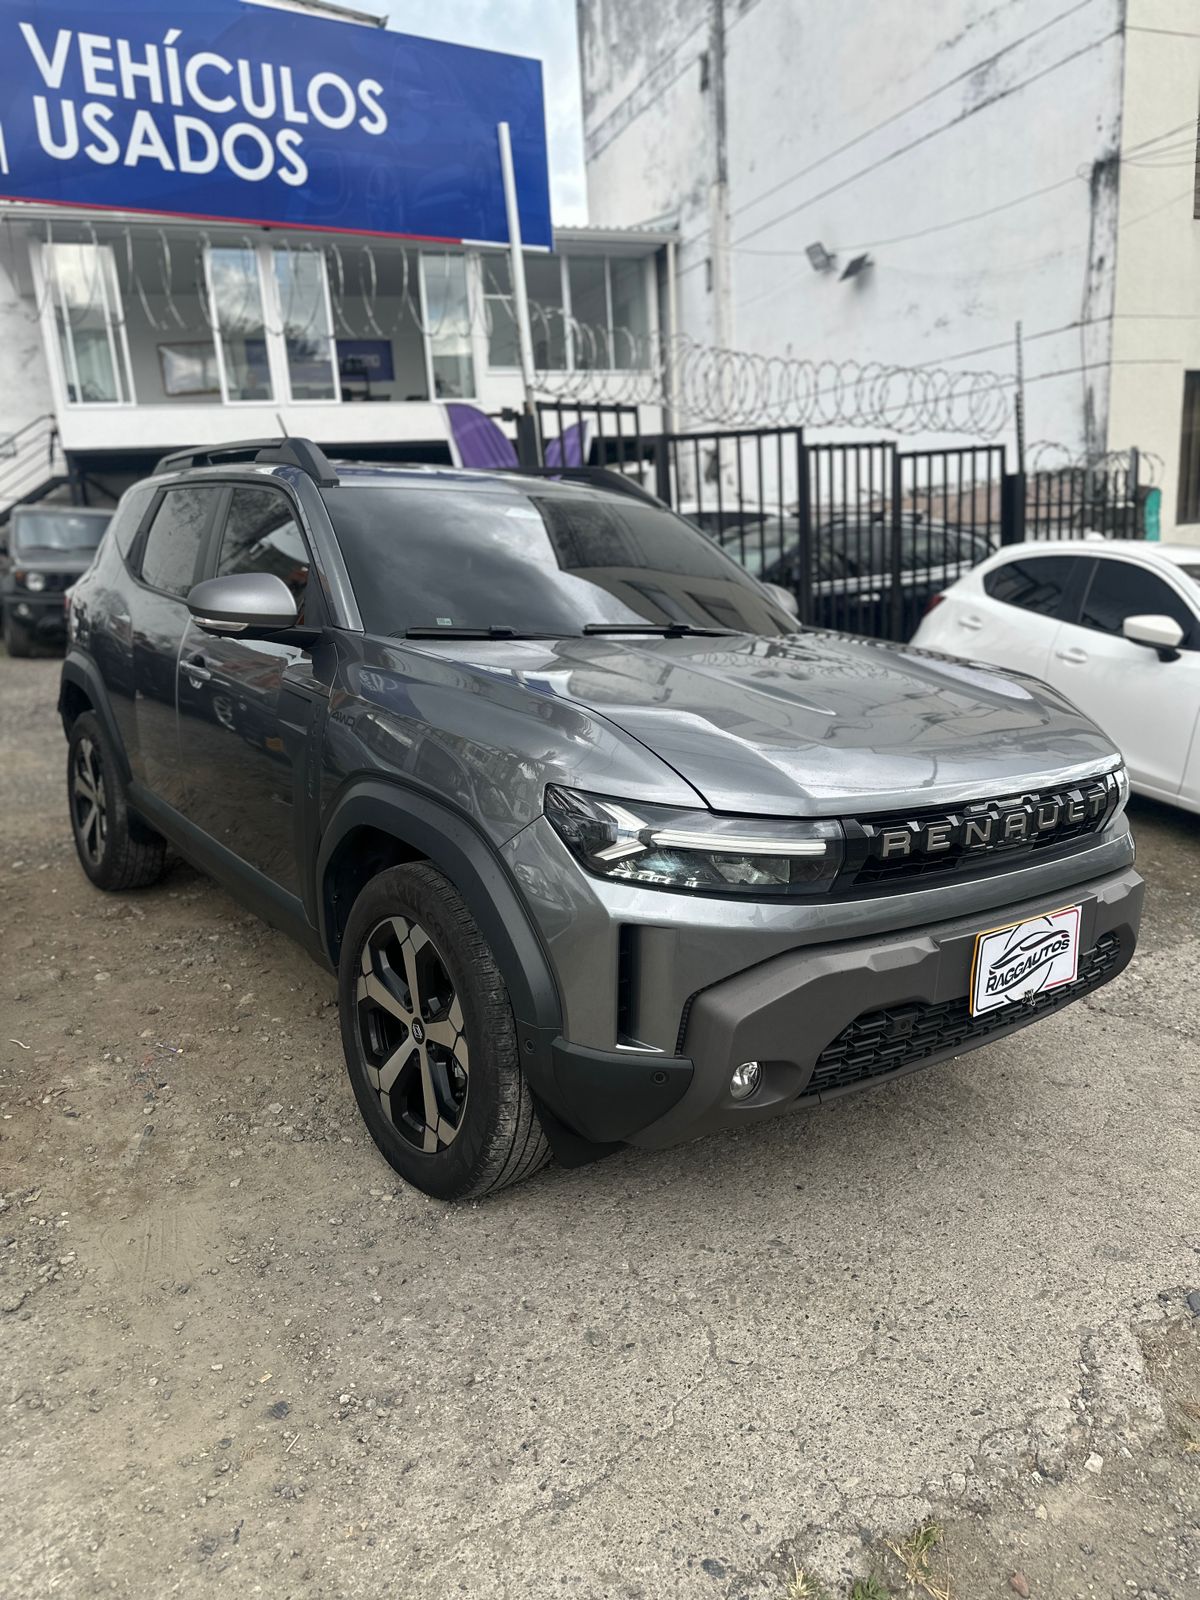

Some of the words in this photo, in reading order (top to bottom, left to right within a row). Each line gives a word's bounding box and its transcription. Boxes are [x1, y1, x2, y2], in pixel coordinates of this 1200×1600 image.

[19, 21, 389, 136] VEHÍCULOS
[33, 94, 309, 187] USADOS
[331, 710, 356, 728] 4WD
[882, 792, 1106, 858] RENAULT
[985, 938, 1071, 994] RAGGAUTOS
